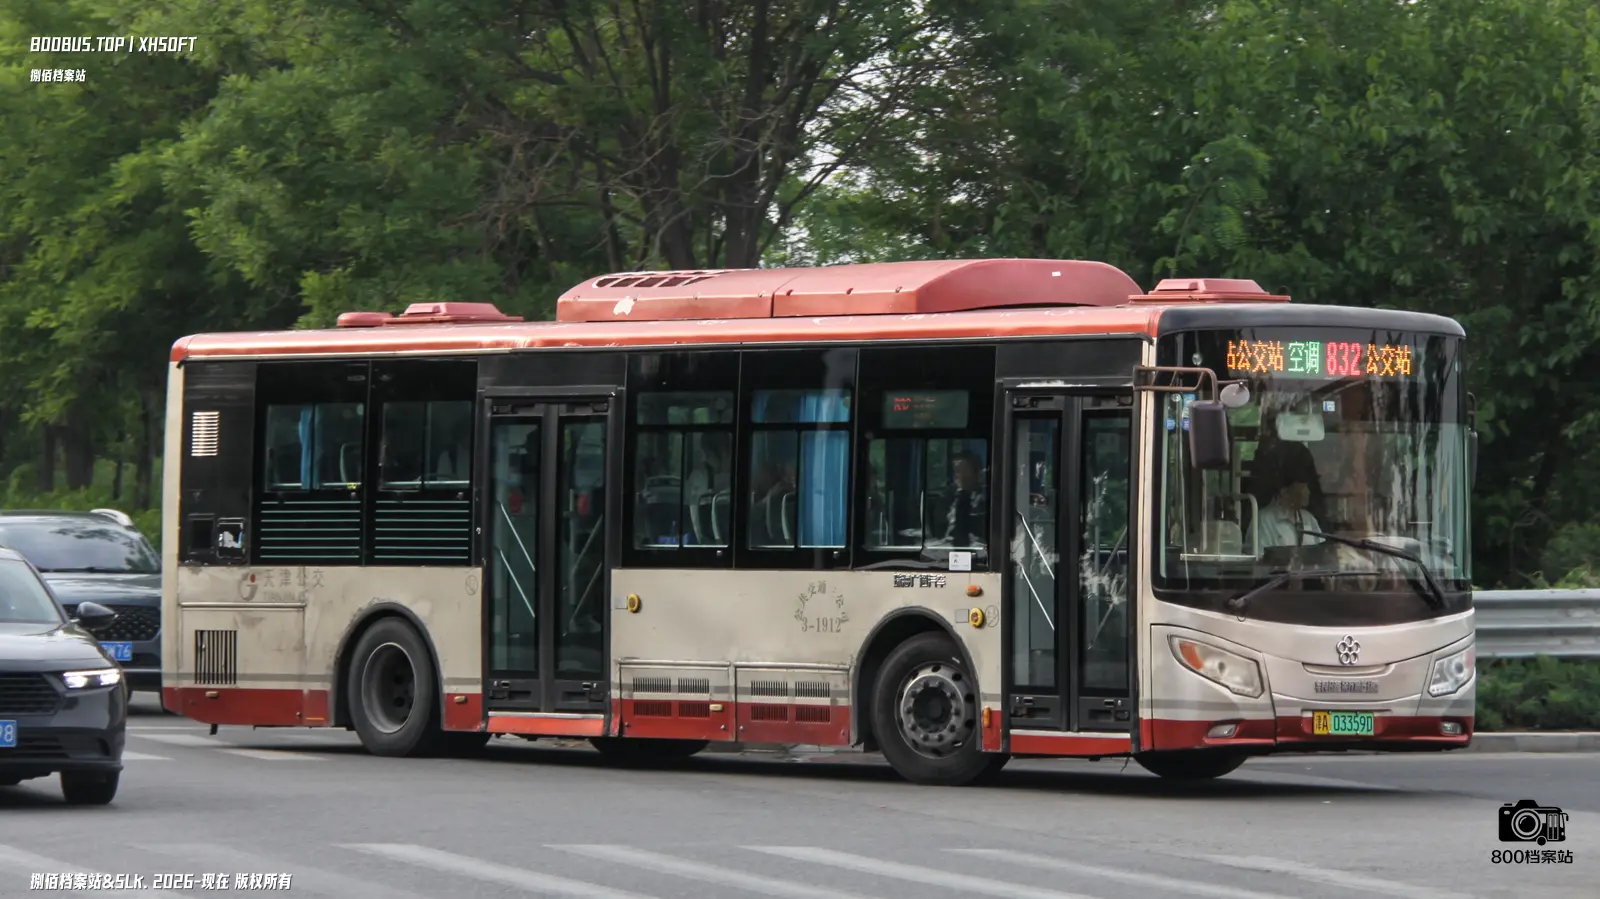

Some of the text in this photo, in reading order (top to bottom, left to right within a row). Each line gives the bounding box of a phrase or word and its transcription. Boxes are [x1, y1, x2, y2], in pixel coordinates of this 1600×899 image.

[1288, 341, 1320, 374] 空调
[1326, 342, 1362, 376] 832
[1366, 344, 1412, 376] 公交站
[263, 567, 325, 588] 天津公交
[801, 617, 842, 633] 3-1912
